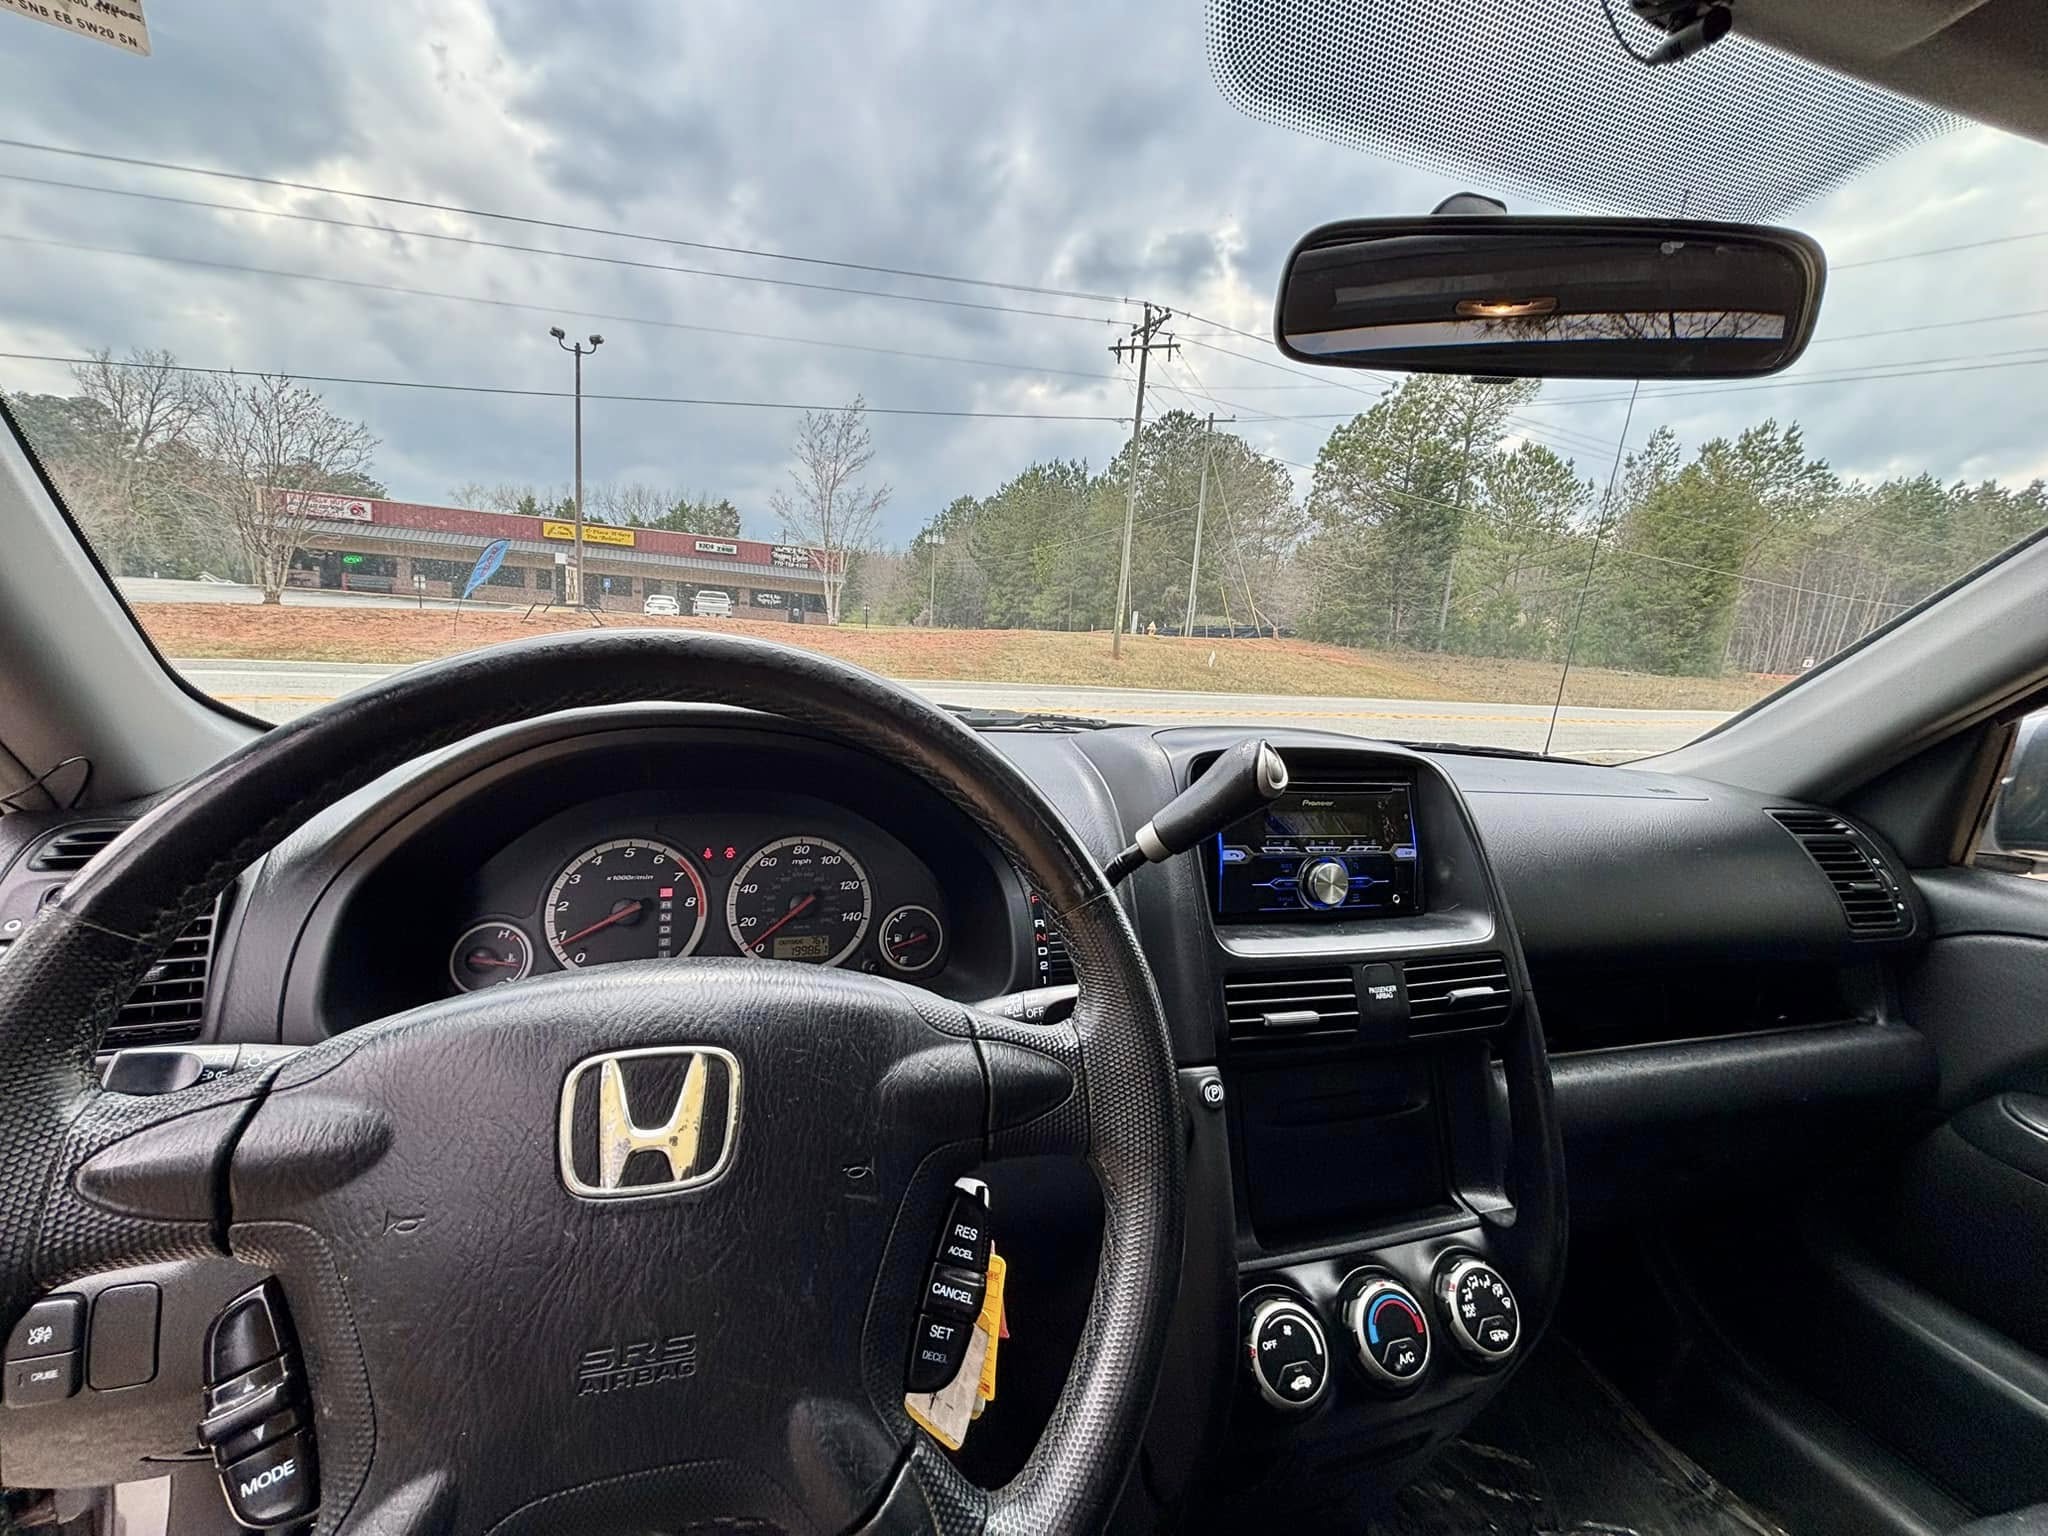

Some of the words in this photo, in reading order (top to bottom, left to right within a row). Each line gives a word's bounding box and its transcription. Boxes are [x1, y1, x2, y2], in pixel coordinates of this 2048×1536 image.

[54, 10, 73, 25] EB
[76, 18, 115, 39] 5W20
[118, 33, 138, 47] SN
[1302, 799, 1334, 807] Pioneer
[624, 848, 636, 858] 5
[793, 846, 810, 855] 80
[592, 855, 602, 866] 4
[653, 854, 665, 864] 6
[760, 858, 777, 867] 60
[820, 856, 841, 865] 100
[569, 874, 581, 884] 3
[673, 872, 685, 882] 7
[740, 884, 758, 894] 40
[840, 881, 859, 890] 120
[557, 901, 569, 911] 2
[685, 897, 696, 907] 8
[740, 917, 757, 927] 20
[841, 912, 862, 922] 140
[1034, 920, 1045, 928] R
[498, 930, 509, 939] H
[560, 931, 567, 941] 1
[1036, 933, 1047, 941] N
[755, 943, 765, 953] 0
[1038, 946, 1048, 956] D
[575, 953, 586, 963] 0
[1040, 961, 1049, 970] 2
[1043, 976, 1047, 984] 1
[1026, 1006, 1044, 1018] OFF
[954, 1224, 978, 1241] RES
[948, 1245, 974, 1261] ACCEL
[932, 1282, 974, 1305] CANCEL
[30, 1326, 52, 1338] VSA
[929, 1324, 954, 1341] SET
[28, 1334, 51, 1345] OFF
[1262, 1339, 1278, 1351] OFF
[579, 1334, 697, 1375] SRS
[922, 1350, 948, 1364] DECEL
[1400, 1351, 1415, 1365] A/C
[578, 1361, 697, 1397] AIRBAG
[241, 1458, 296, 1498] MODE
